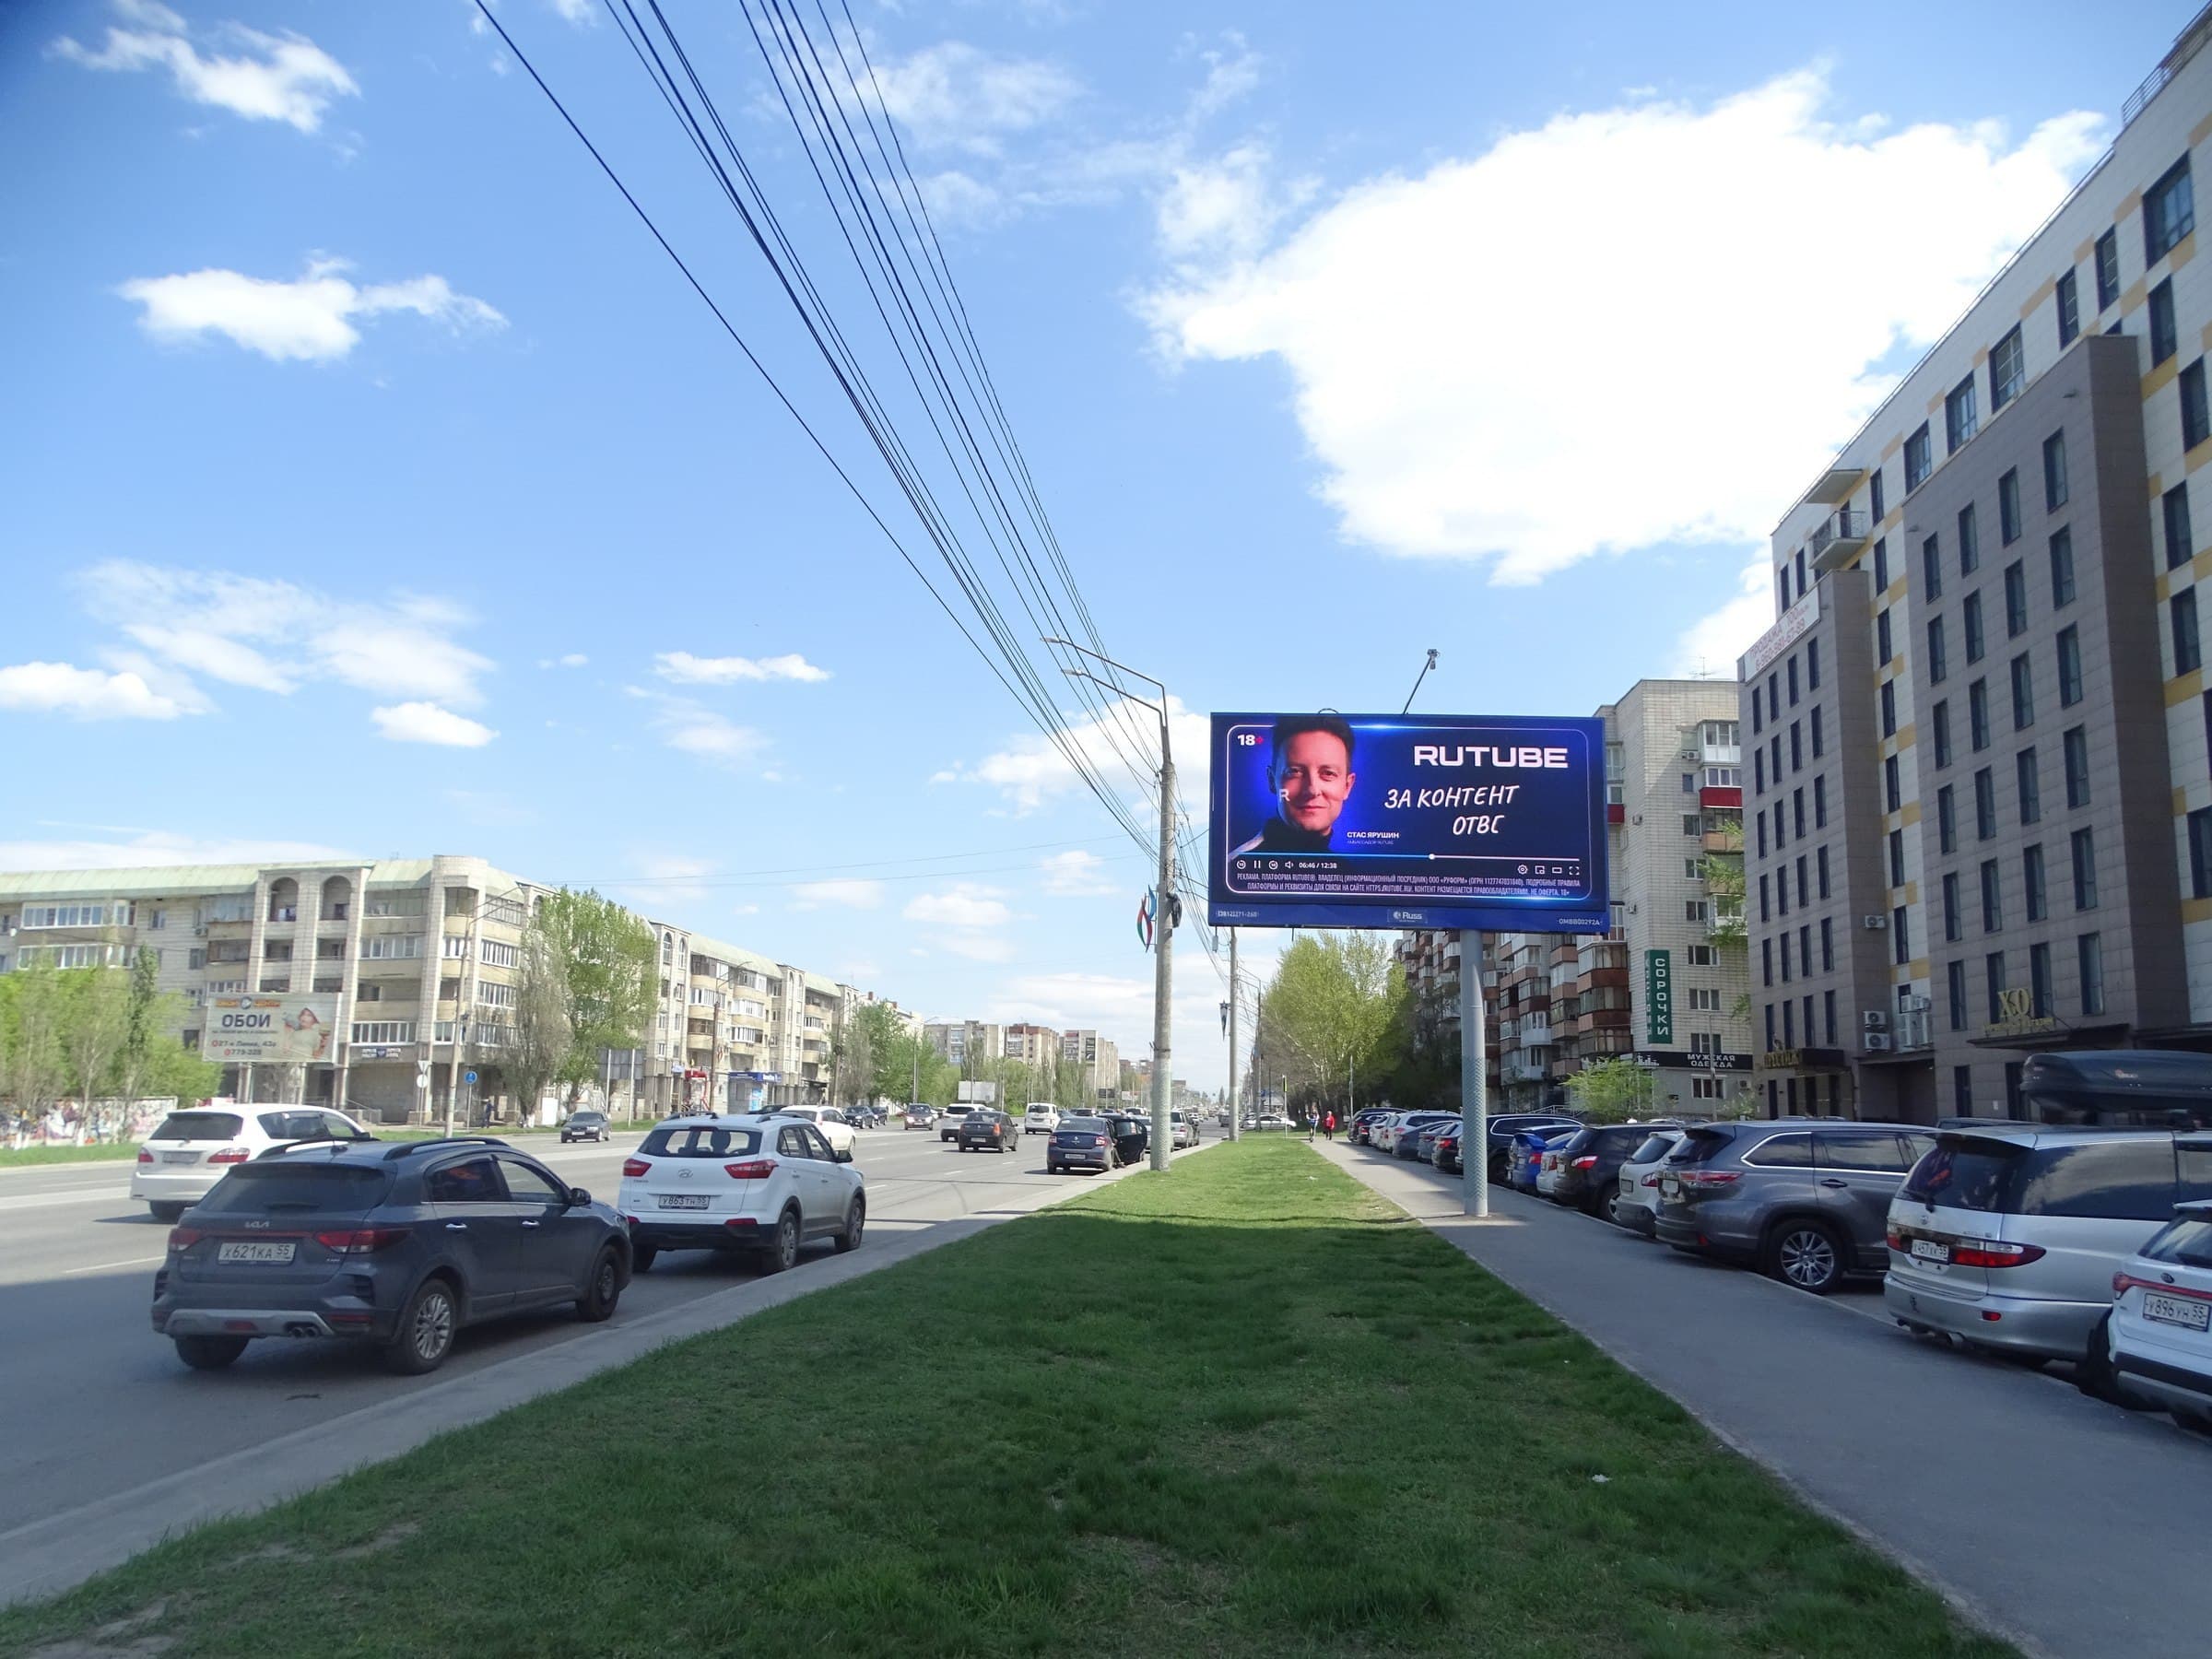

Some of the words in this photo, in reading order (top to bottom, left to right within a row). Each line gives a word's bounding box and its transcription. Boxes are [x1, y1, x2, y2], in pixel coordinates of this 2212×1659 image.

[1414, 746, 1569, 769] RUTUBE
[1384, 788, 1412, 809] ЗА
[1417, 785, 1520, 808] КОНТЕНТ
[1367, 831, 1400, 840] ЯРУШИН
[1261, 873, 1291, 881] ПЛАТФОРМА
[1402, 912, 1423, 920] Russ
[1654, 958, 1669, 1036] СОРОЧКИ
[221, 1014, 271, 1028] ОБОИ
[223, 1245, 273, 1259] Х621КА
[276, 1244, 290, 1255] 55
